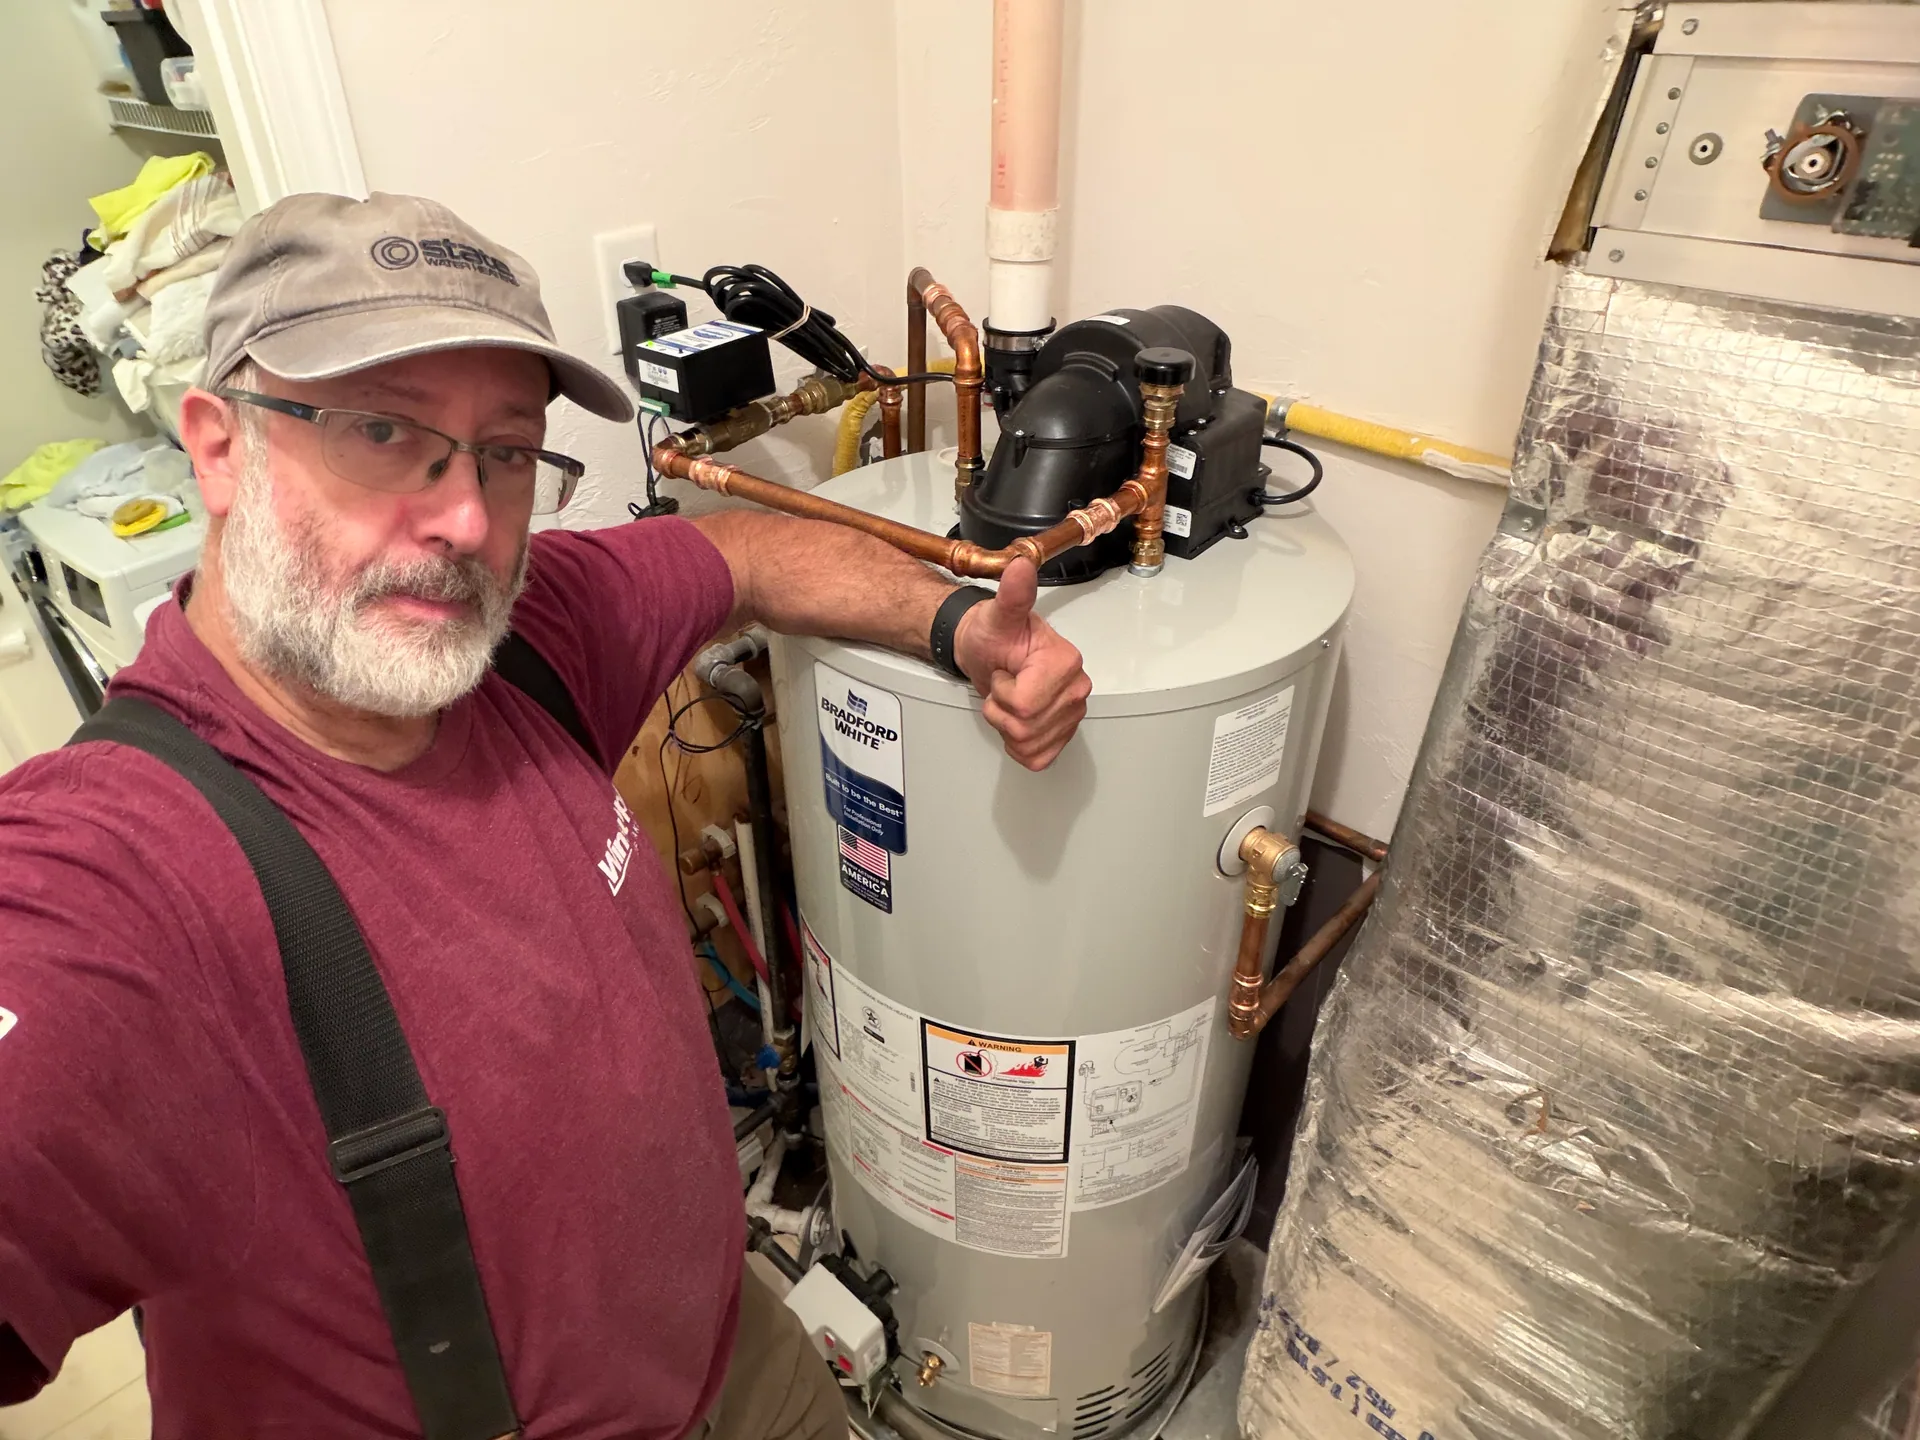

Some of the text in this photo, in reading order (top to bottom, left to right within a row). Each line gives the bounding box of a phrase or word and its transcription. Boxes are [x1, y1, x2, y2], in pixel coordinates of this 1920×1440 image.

[419, 238, 514, 276] state
[821, 696, 898, 742] BRADFORD
[834, 717, 881, 750] WHITE
[825, 772, 841, 788] Built
[841, 783, 850, 793] to
[850, 789, 862, 800] be
[863, 795, 877, 808] the
[851, 808, 882, 828] Professional
[871, 824, 884, 836] Only
[841, 864, 889, 898] AMERICA
[978, 1041, 1022, 1053] WARNING
